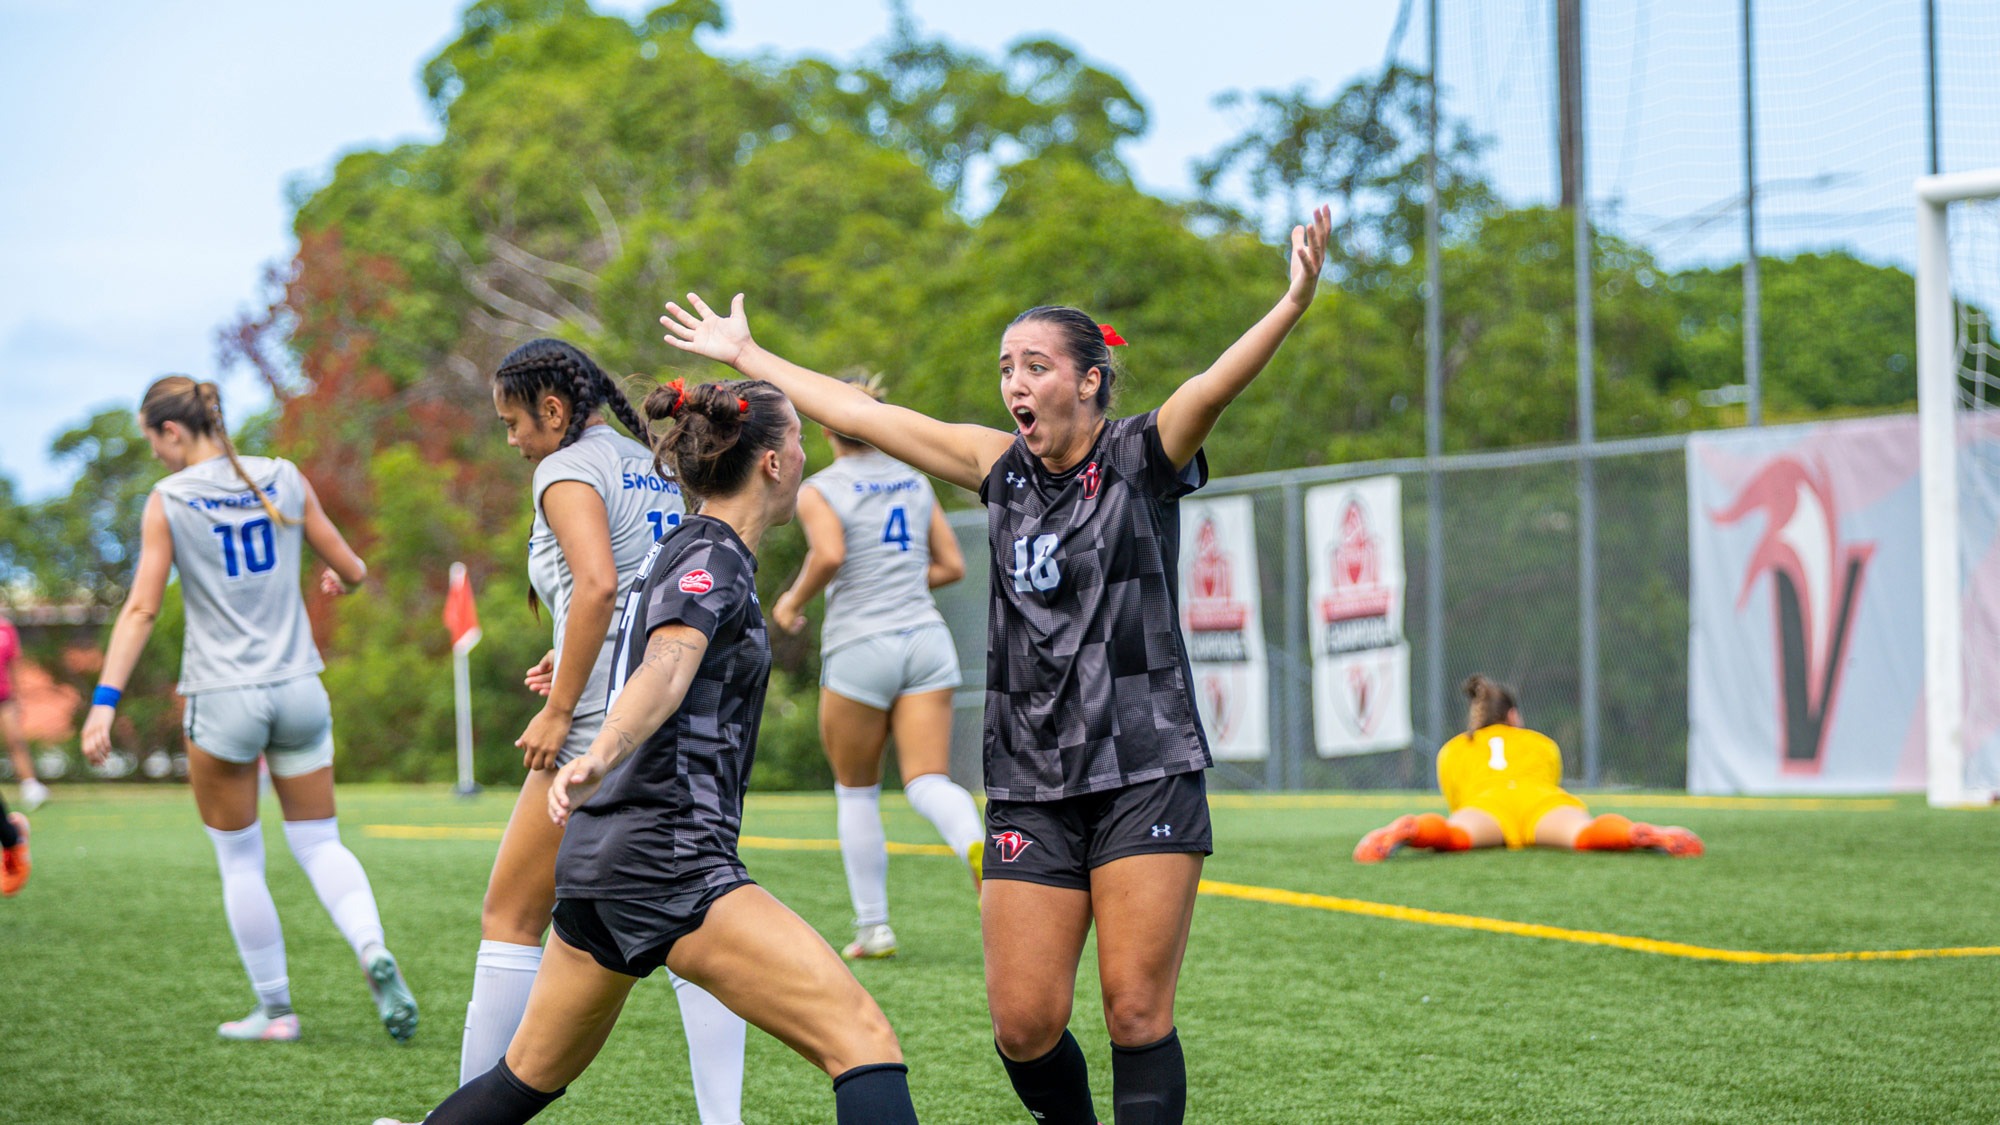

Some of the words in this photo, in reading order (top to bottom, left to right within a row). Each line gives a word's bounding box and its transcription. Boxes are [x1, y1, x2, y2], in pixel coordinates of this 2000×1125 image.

[623, 472, 684, 497] SWORD
[213, 517, 277, 577] 10
[883, 507, 911, 552] 4
[1014, 533, 1061, 592] 18
[1487, 736, 1509, 770] 1
